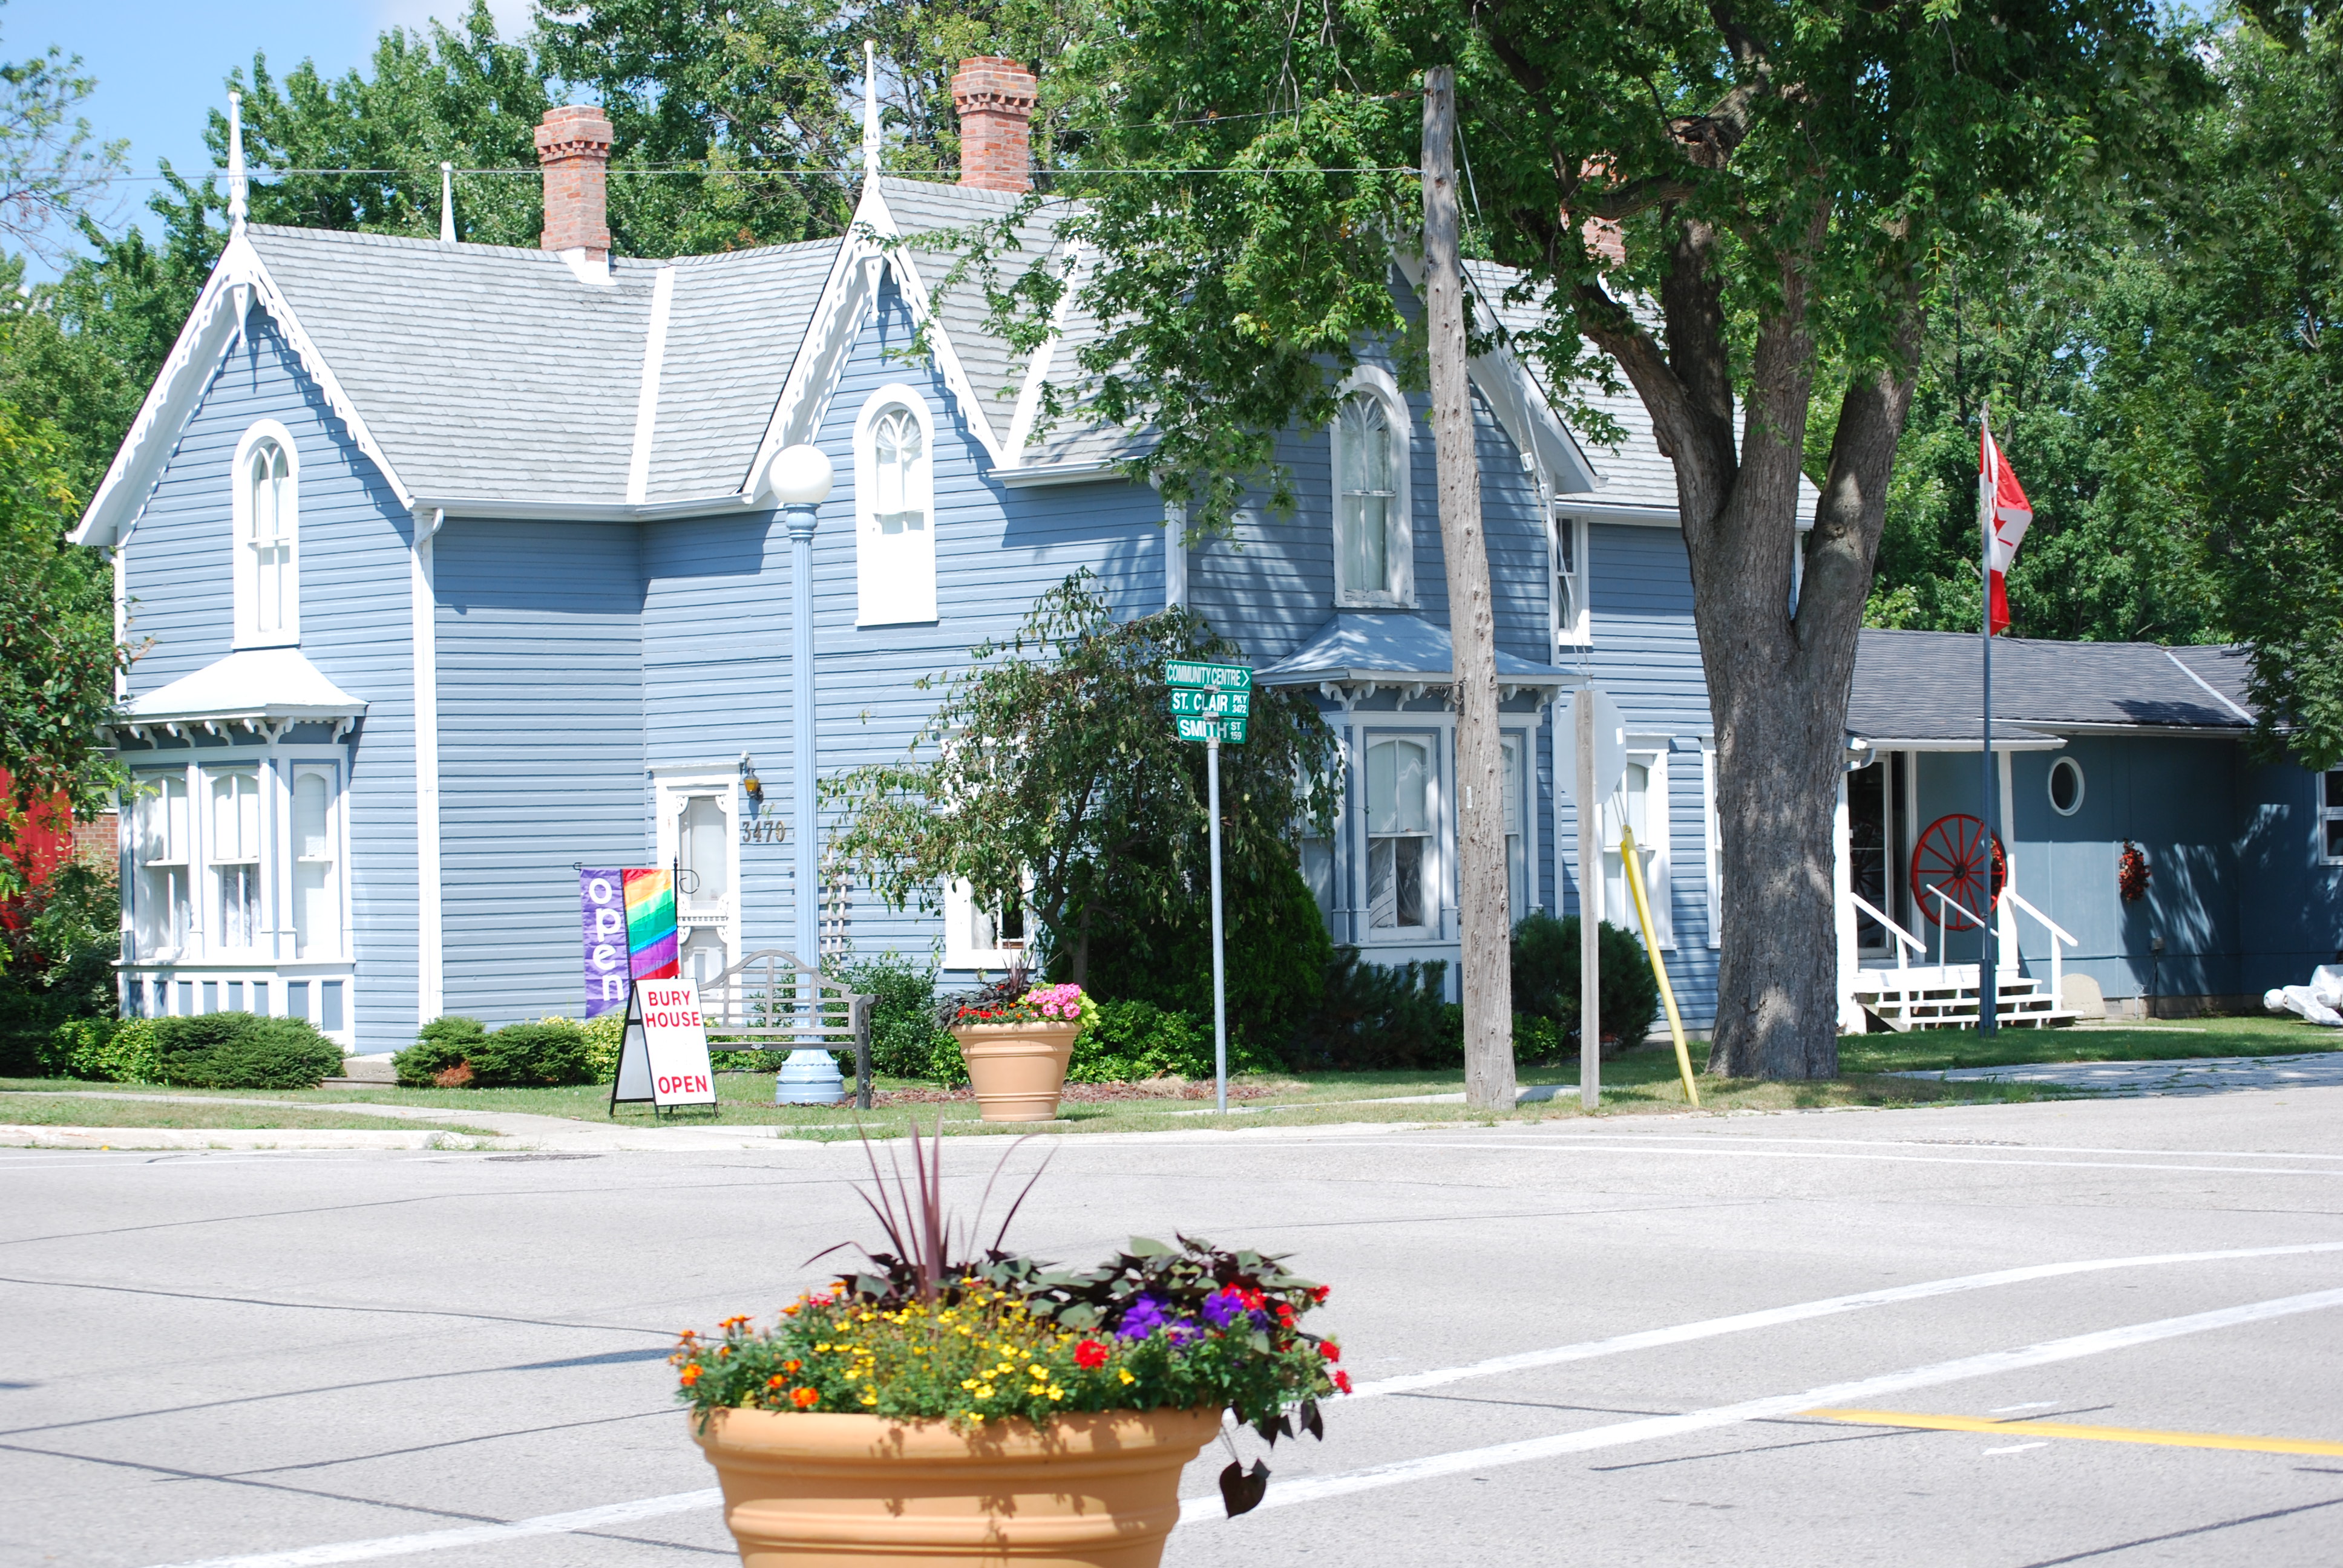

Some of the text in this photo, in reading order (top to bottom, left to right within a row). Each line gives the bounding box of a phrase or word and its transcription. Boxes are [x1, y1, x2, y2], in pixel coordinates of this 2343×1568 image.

[1167, 664, 1240, 687] COMMUNITY CENTRE
[1172, 692, 1228, 712] ST. CLAIR
[1233, 694, 1248, 704] PKY
[1232, 704, 1247, 714] 3472
[1179, 719, 1228, 739] SMITH
[1230, 721, 1242, 731] ST
[1230, 731, 1242, 740] 159
[742, 820, 785, 843] 3470
[588, 877, 625, 1001] open
[648, 990, 690, 1007] BURY
[645, 1011, 701, 1028] HOUSE
[658, 1075, 708, 1094] OPEN
